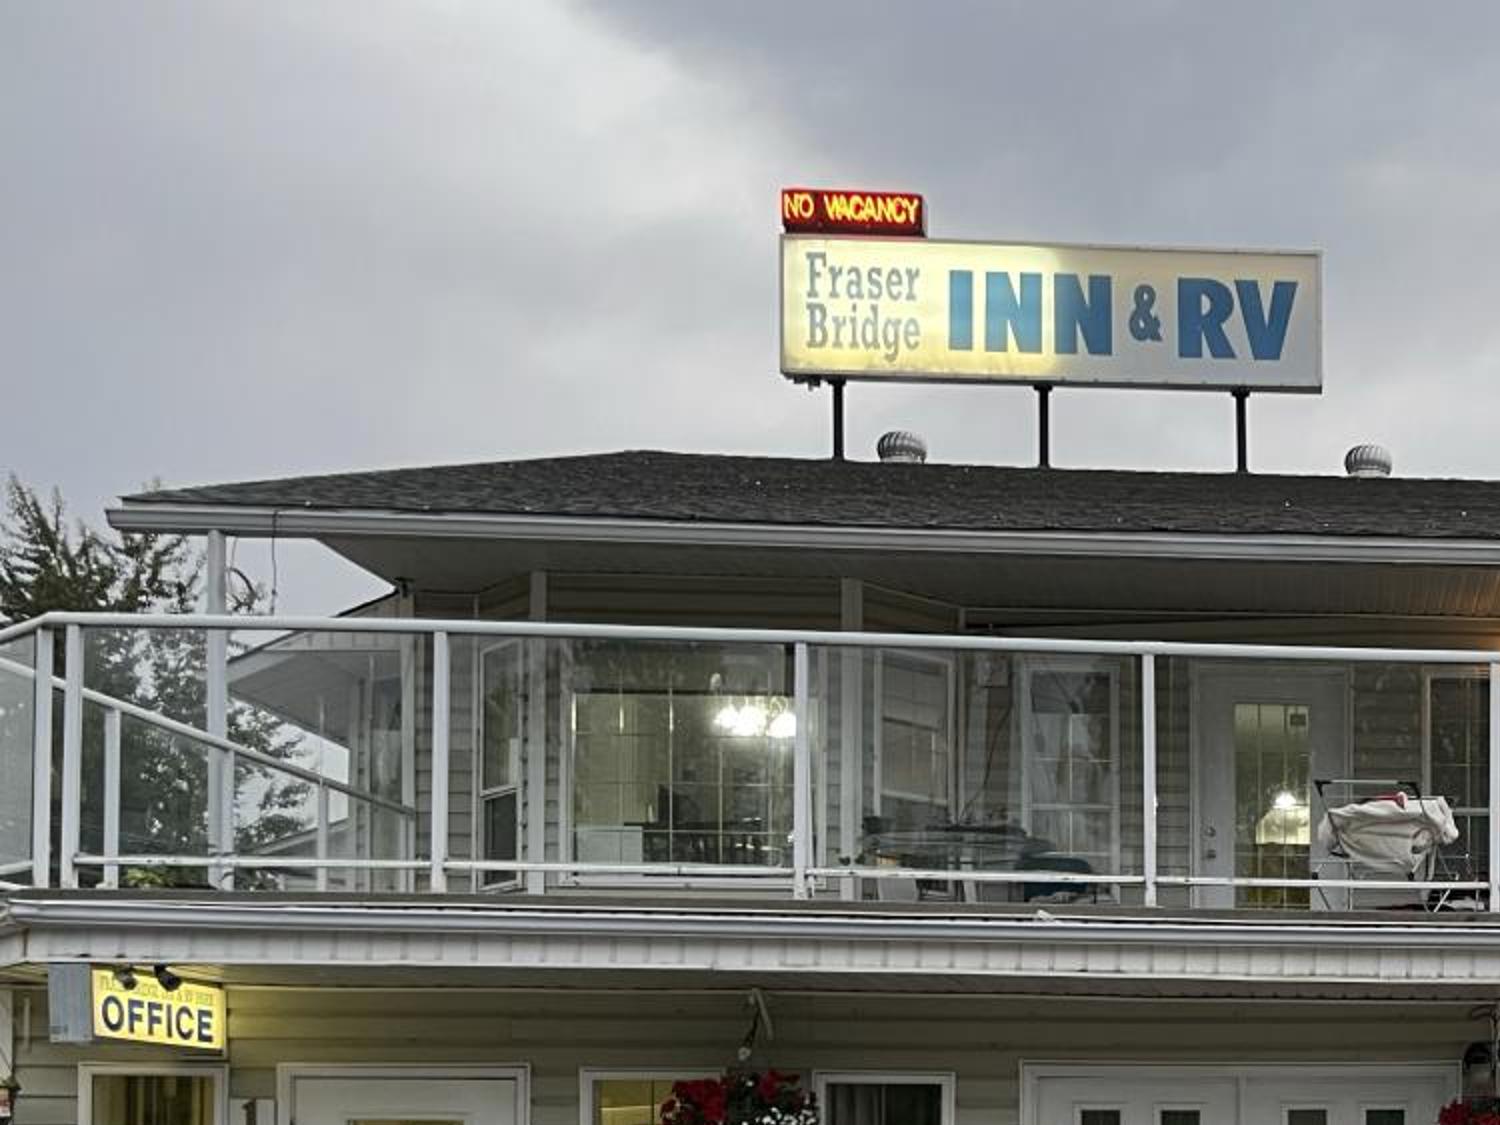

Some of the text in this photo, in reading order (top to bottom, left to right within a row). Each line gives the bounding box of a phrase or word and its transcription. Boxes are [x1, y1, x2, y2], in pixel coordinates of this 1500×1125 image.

[784, 193, 919, 224] NO VACANCY
[806, 252, 920, 301] Fraser
[806, 301, 921, 362] Bridge
[948, 270, 1298, 361] INN & RV
[101, 995, 213, 1043] OFFICE
